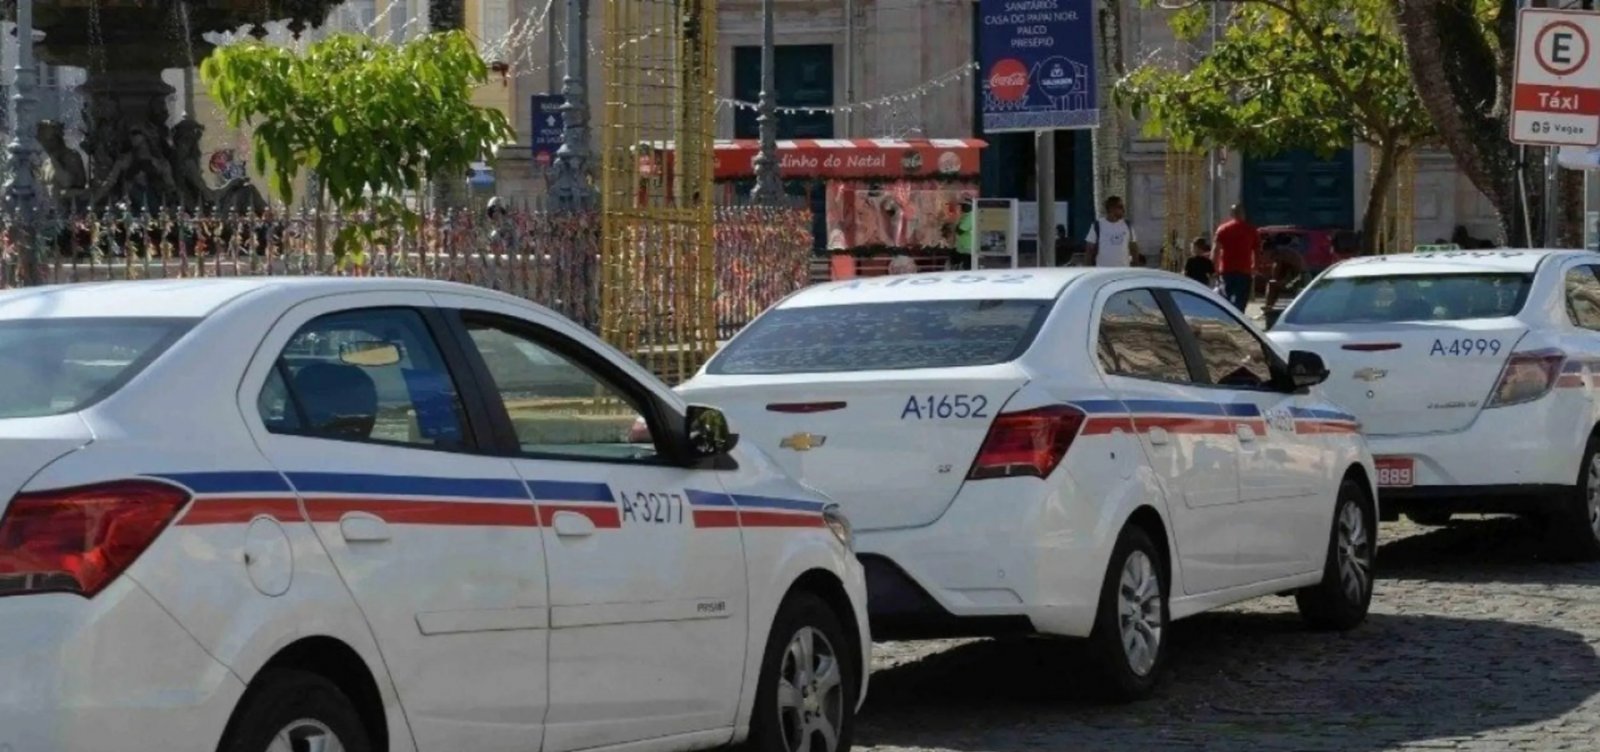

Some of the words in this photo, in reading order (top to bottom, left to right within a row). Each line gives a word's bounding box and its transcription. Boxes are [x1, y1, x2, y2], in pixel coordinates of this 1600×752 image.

[984, 14, 1009, 26] CASA
[1010, 14, 1025, 24] DO
[1026, 13, 1053, 23] PAPAI
[1054, 10, 1079, 21] NOEL
[1016, 25, 1047, 35] PALCO
[1552, 33, 1573, 63] E
[1538, 90, 1579, 110] Táxi
[823, 153, 841, 168] do
[847, 153, 885, 168] Natal
[1430, 338, 1501, 356] A-4999
[901, 394, 987, 420] A-1652
[620, 491, 682, 524] A-3277
